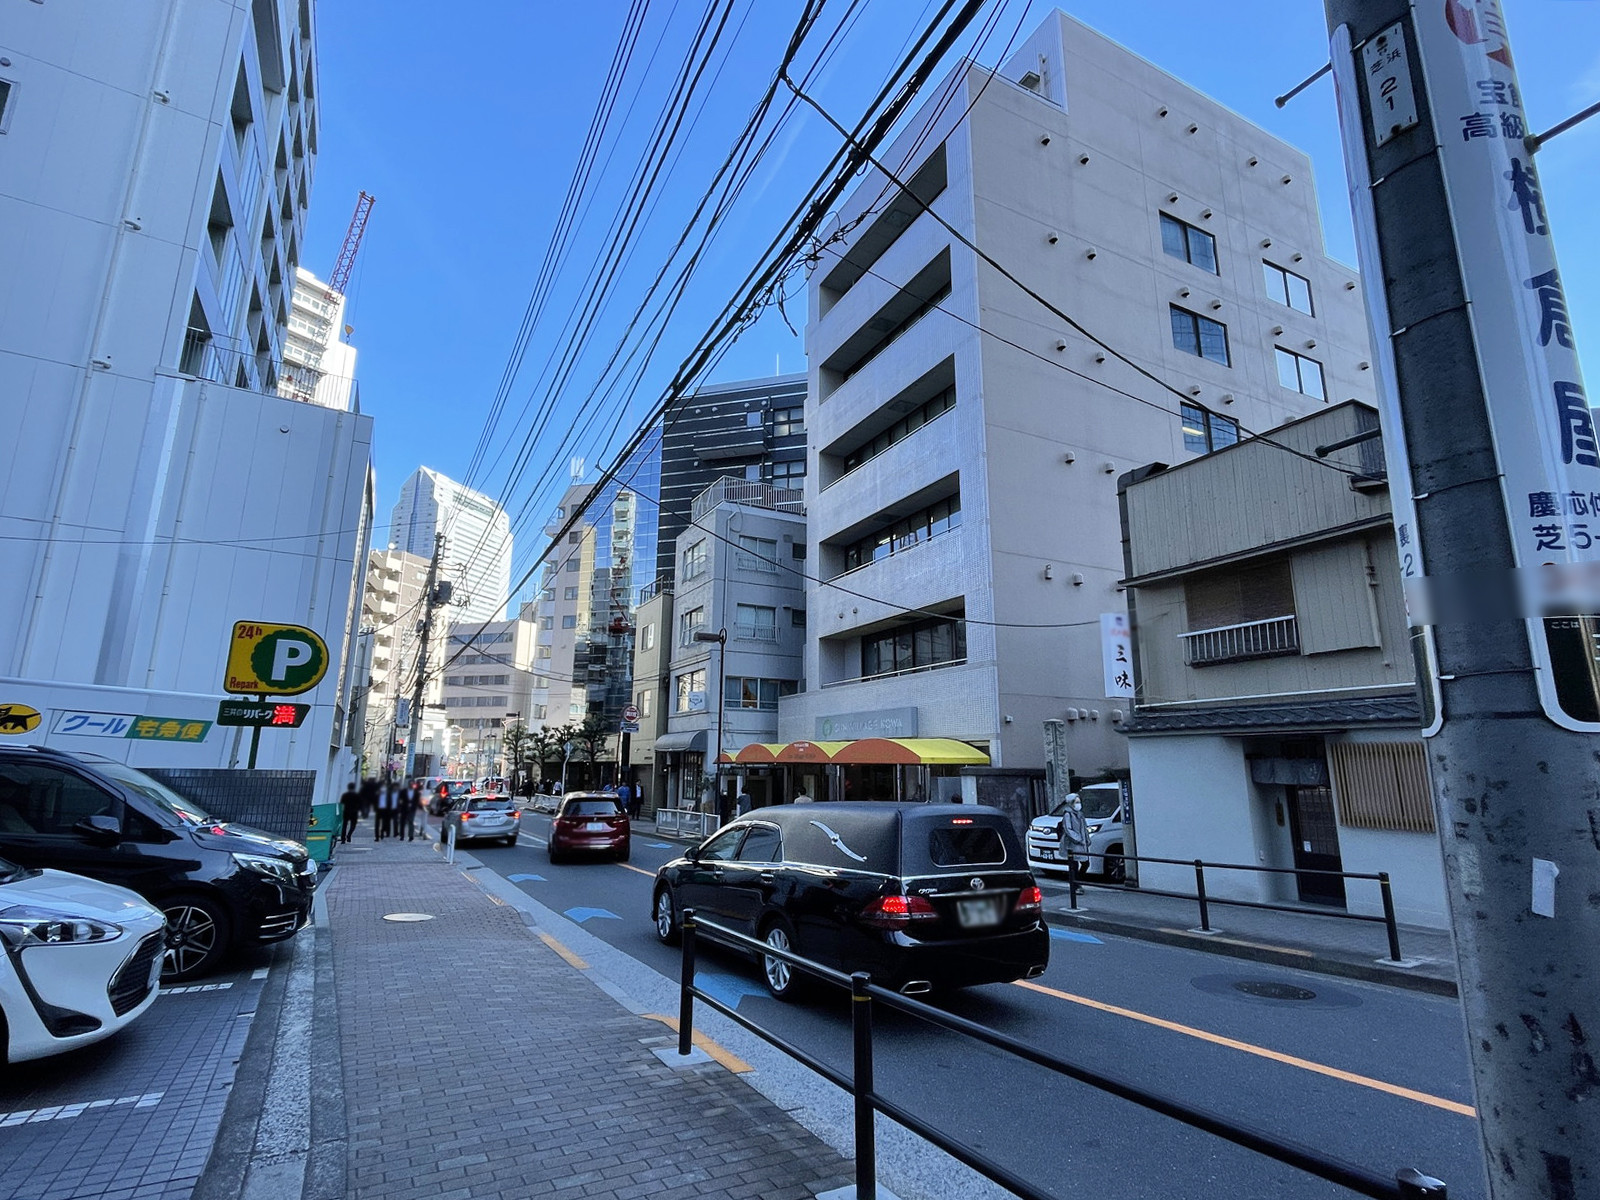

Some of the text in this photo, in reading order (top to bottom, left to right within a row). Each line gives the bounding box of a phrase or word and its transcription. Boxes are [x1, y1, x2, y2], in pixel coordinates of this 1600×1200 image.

[1460, 111, 1525, 141] 高級
[271, 638, 313, 681] P
[229, 676, 259, 690] Repark
[62, 714, 205, 740] クール 宅急便
[272, 704, 296, 725] 満
